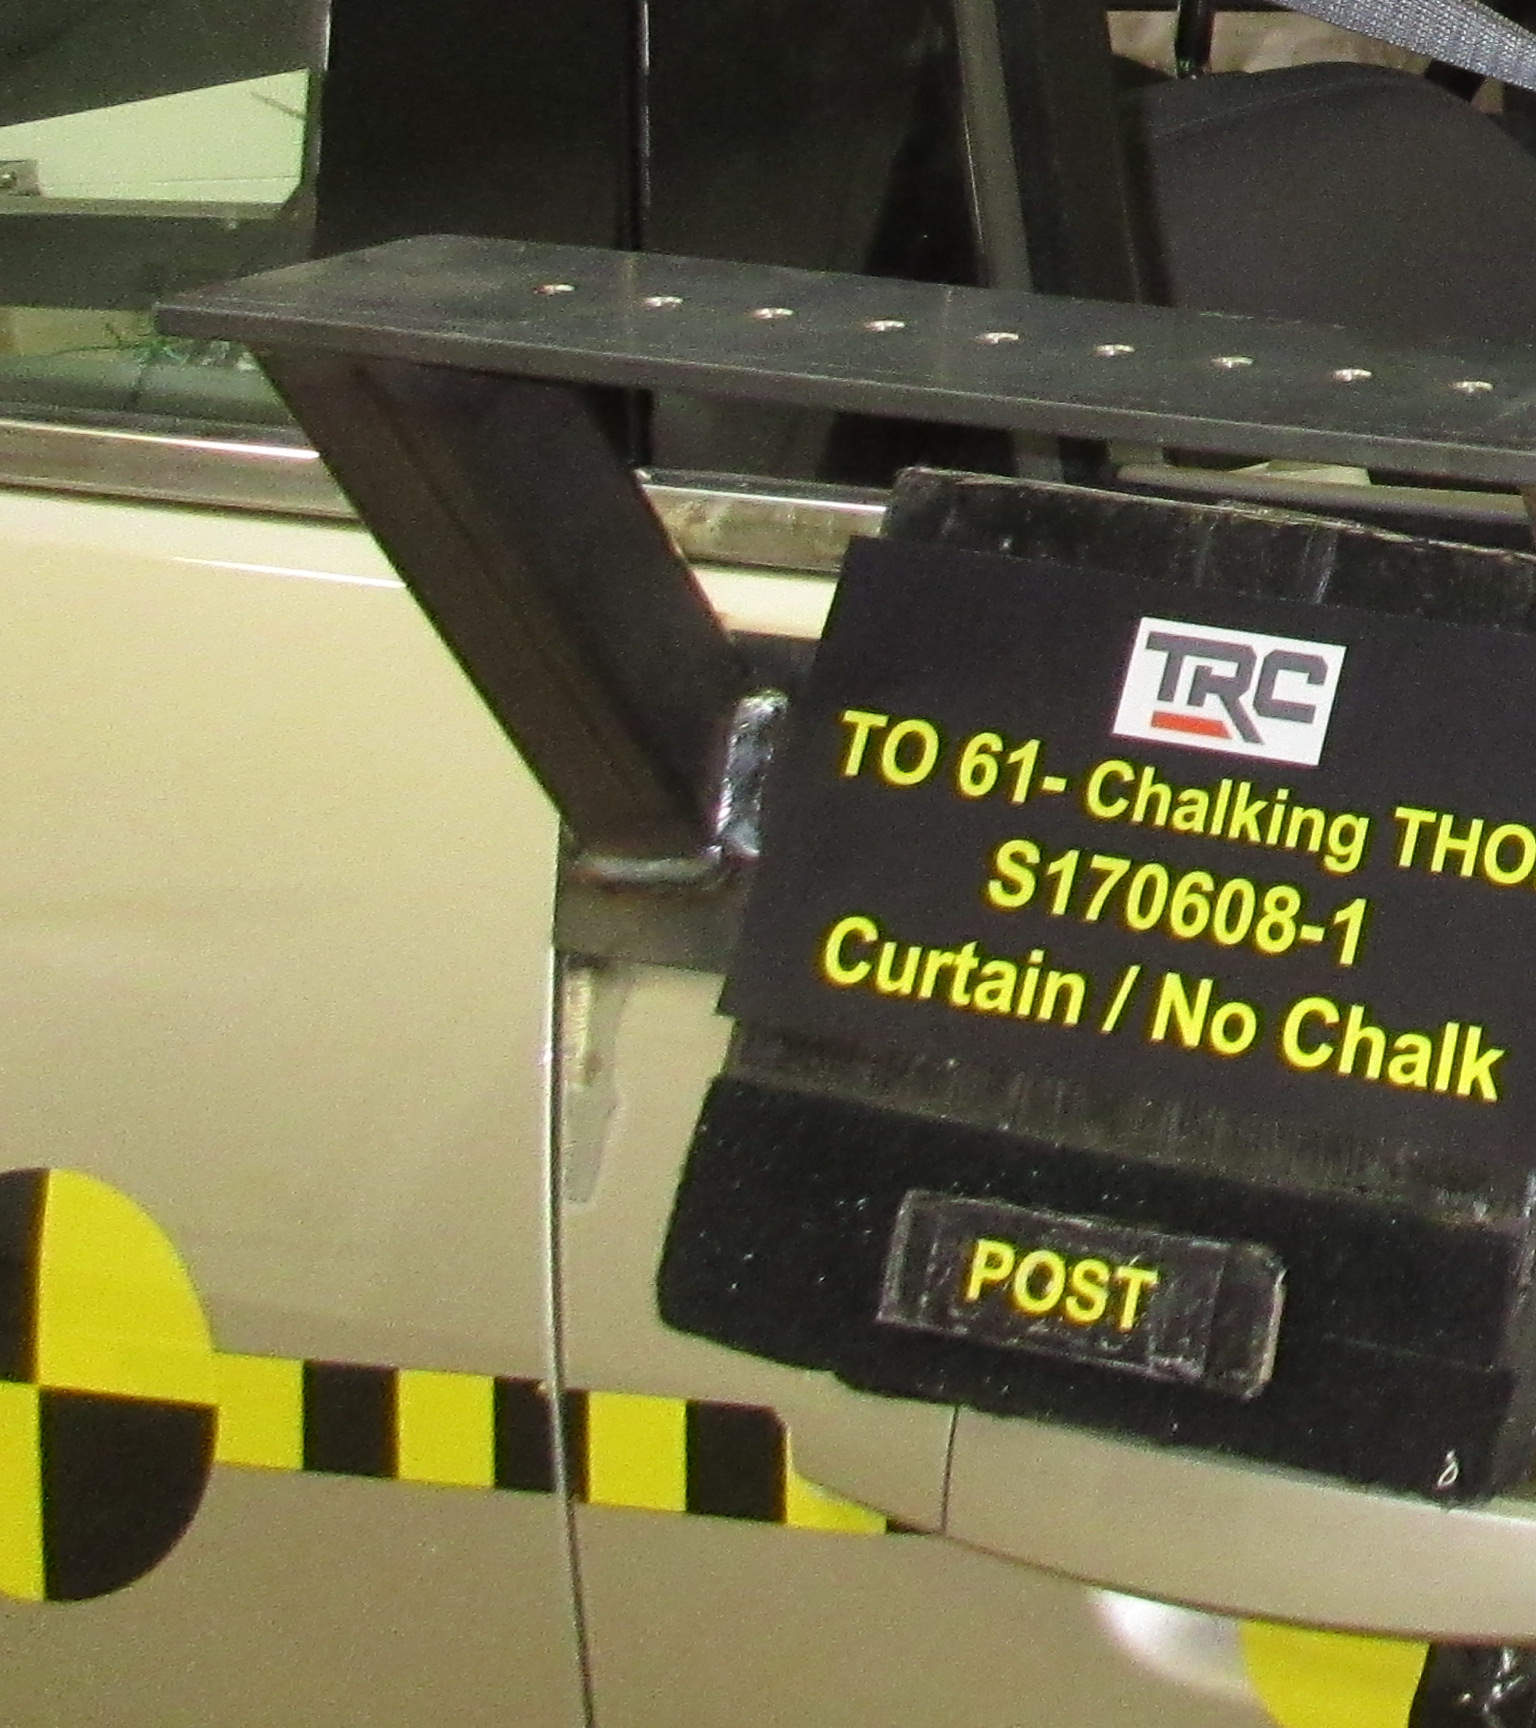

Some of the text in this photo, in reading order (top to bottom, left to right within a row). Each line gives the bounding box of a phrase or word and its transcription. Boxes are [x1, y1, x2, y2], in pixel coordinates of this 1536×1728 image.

[1146, 630, 1328, 745] TRC
[841, 709, 939, 786] TO
[956, 732, 1068, 804] 61-
[1085, 759, 1370, 874] Chalking
[986, 839, 1367, 968] S170608-1
[822, 916, 1505, 1103] Curtain / No Chalk
[965, 1238, 1160, 1332] POST
